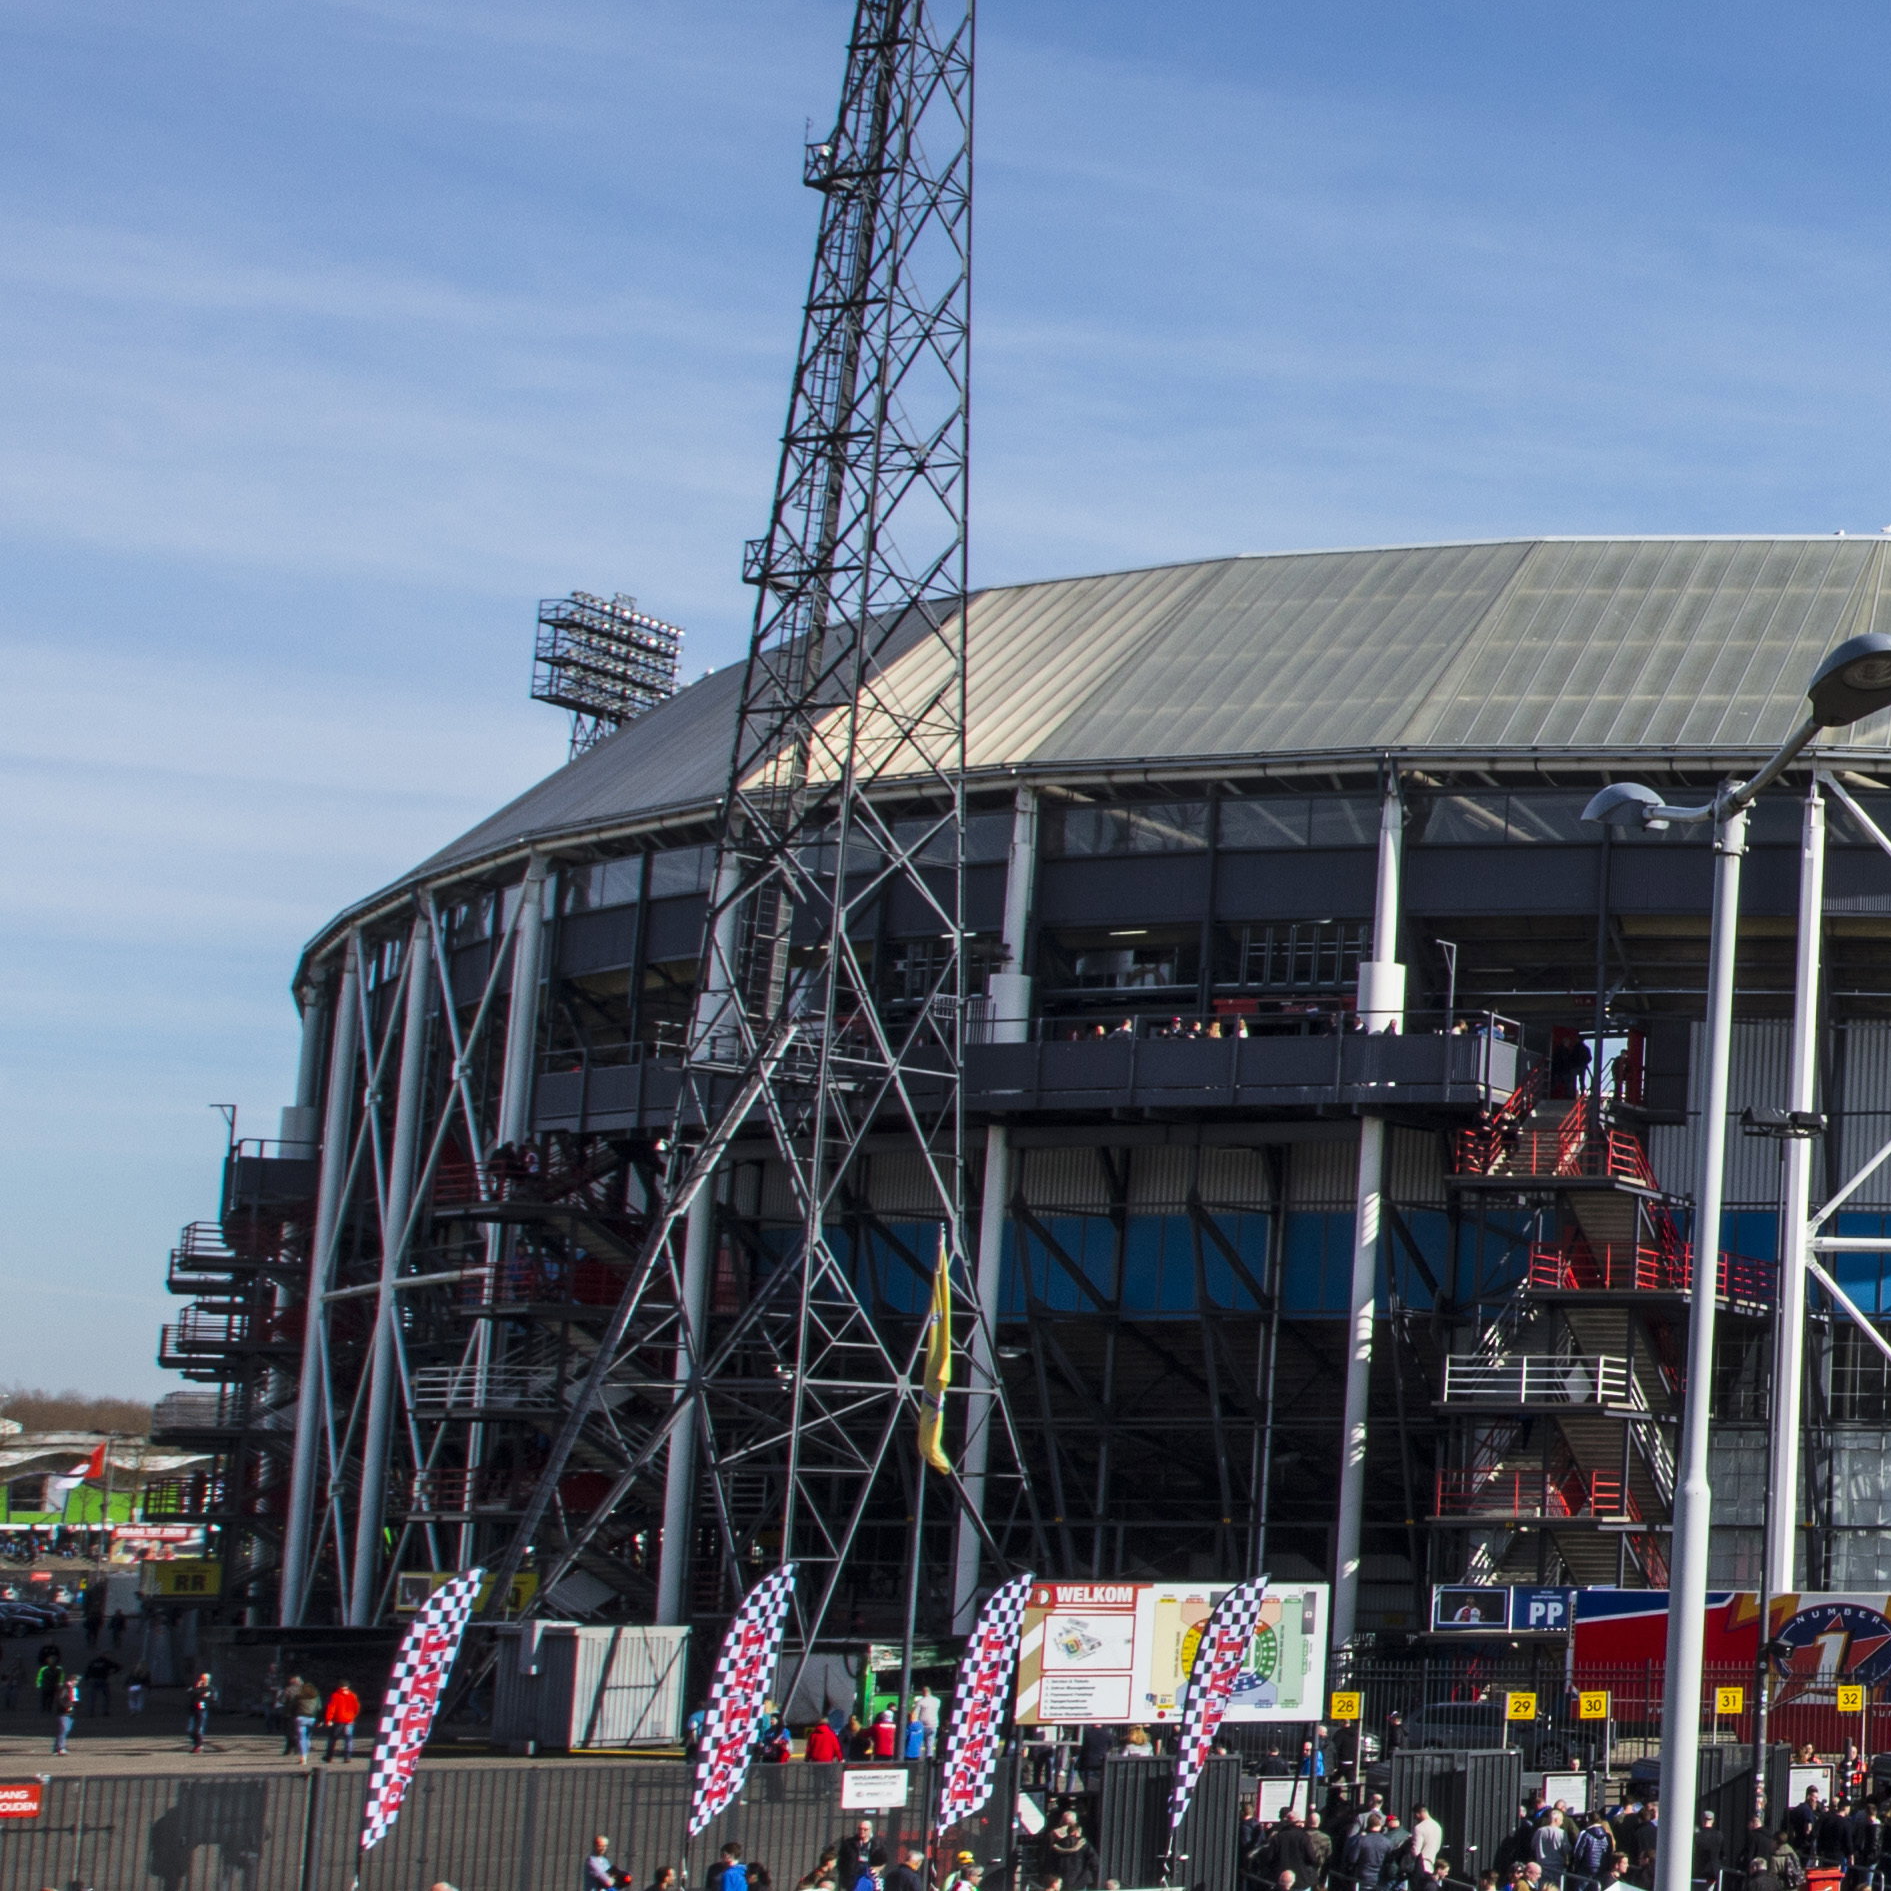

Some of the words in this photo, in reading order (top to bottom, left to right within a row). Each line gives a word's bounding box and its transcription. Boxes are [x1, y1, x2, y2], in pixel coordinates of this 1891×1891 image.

[175, 1574, 205, 1591] RR
[1056, 1586, 1133, 1603] WELKOM
[1529, 1602, 1564, 1625] PP
[1795, 1608, 1881, 1625] NUMBER
[1807, 1631, 1850, 1689] 1
[1337, 1700, 1355, 1713] 28
[1513, 1701, 1531, 1713] 29
[1585, 1700, 1602, 1712] 30
[1722, 1694, 1737, 1707] 31
[1842, 1693, 1858, 1705] 32
[706, 1623, 767, 1808] PATAT
[951, 1626, 1006, 1807] PATAT
